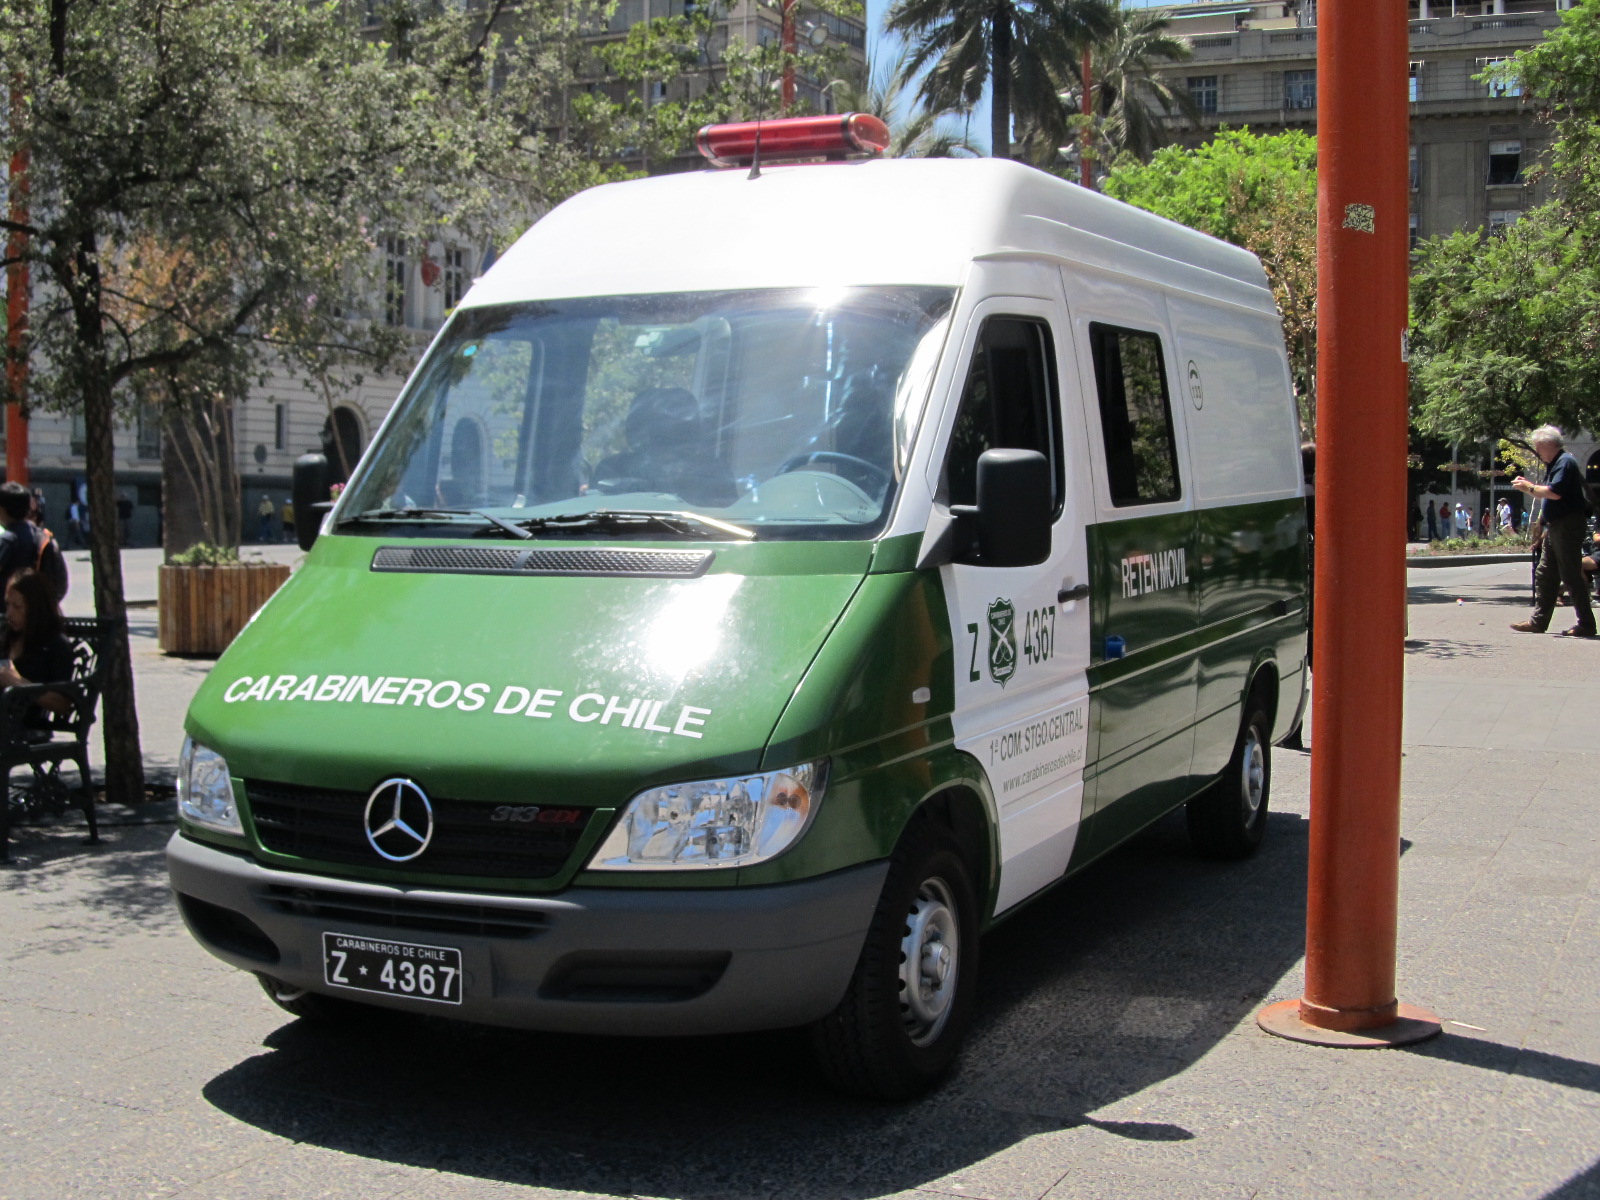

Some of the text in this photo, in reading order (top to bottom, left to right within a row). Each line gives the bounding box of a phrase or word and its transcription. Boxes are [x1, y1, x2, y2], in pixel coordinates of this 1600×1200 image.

[1121, 547, 1190, 599] RETEN MOVIL
[967, 605, 1056, 682] Z 4367
[223, 674, 712, 739] CARABINEROS DE CHILE
[1000, 730, 1023, 761] COM.
[1003, 744, 1083, 793] www.carabinerosdechile.cl
[331, 950, 456, 998] Z 4367
[336, 938, 446, 961] CARABINEROS DE CHILE
